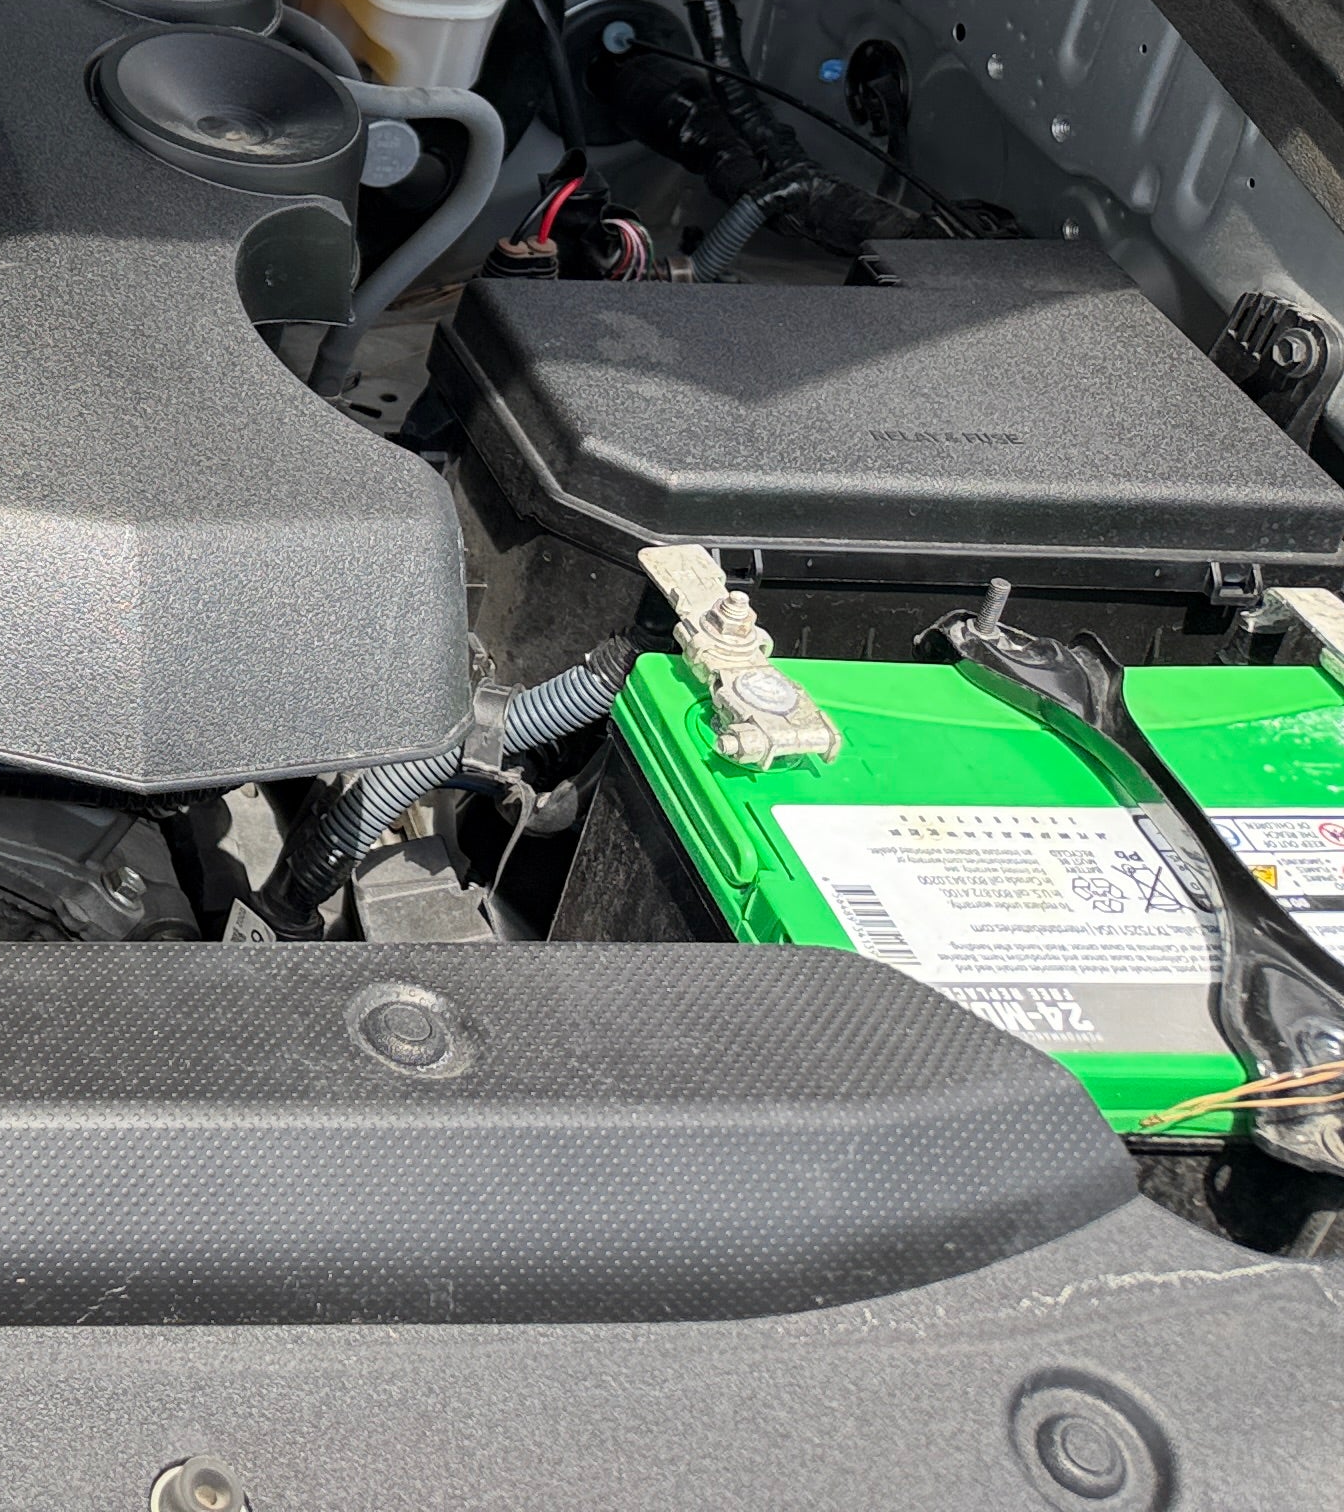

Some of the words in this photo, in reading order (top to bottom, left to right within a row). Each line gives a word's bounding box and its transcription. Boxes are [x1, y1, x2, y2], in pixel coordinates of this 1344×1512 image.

[868, 429, 939, 445] RELAY
[961, 431, 1024, 445] FUSE
[1298, 831, 1320, 839] THE
[1277, 839, 1299, 848] OUT
[1114, 851, 1144, 862] Pb
[1026, 987, 1075, 1000] FREE
